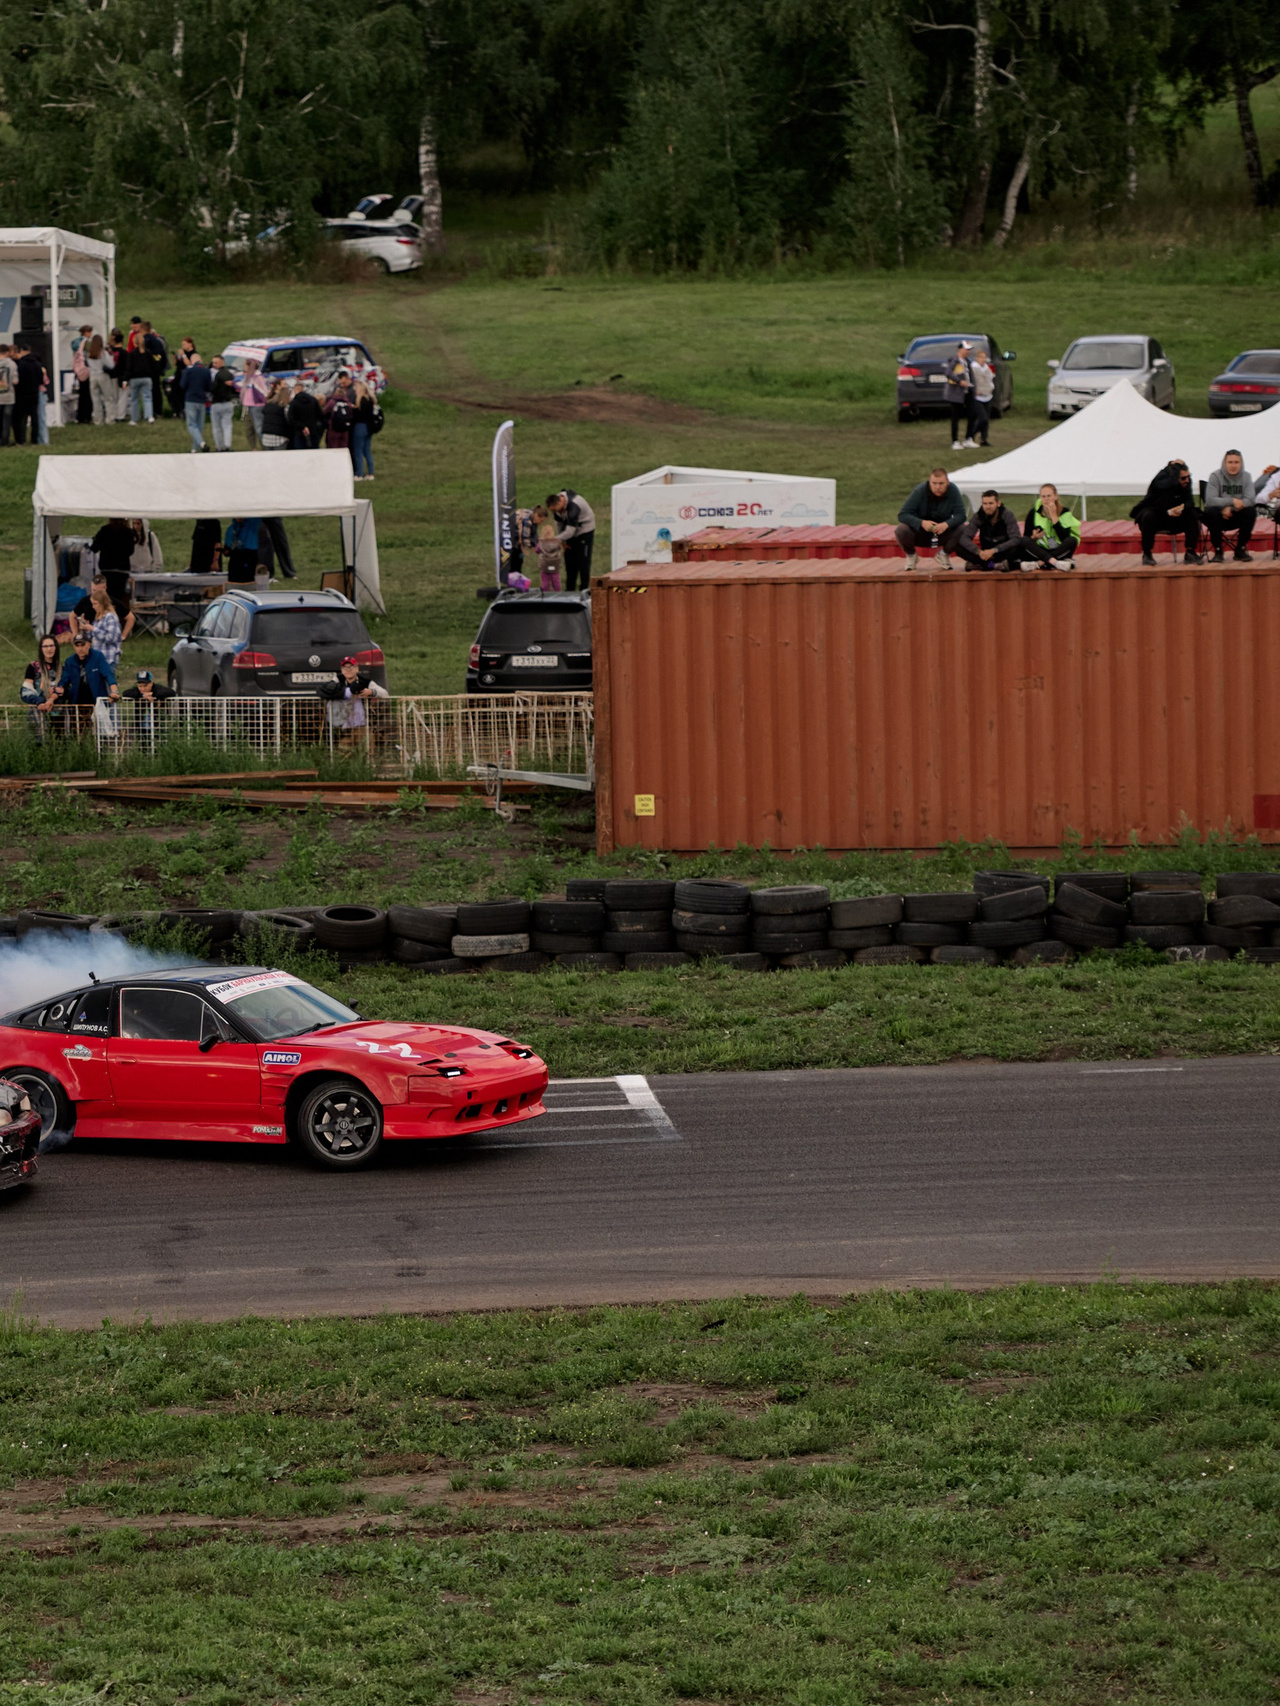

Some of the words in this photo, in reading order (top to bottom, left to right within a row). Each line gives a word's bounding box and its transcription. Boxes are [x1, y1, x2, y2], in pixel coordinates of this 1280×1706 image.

[698, 507, 734, 517] СОЮЗ
[210, 983, 234, 995] КУБОК
[356, 1041, 422, 1058] 22
[265, 1053, 299, 1063] AIMOL
